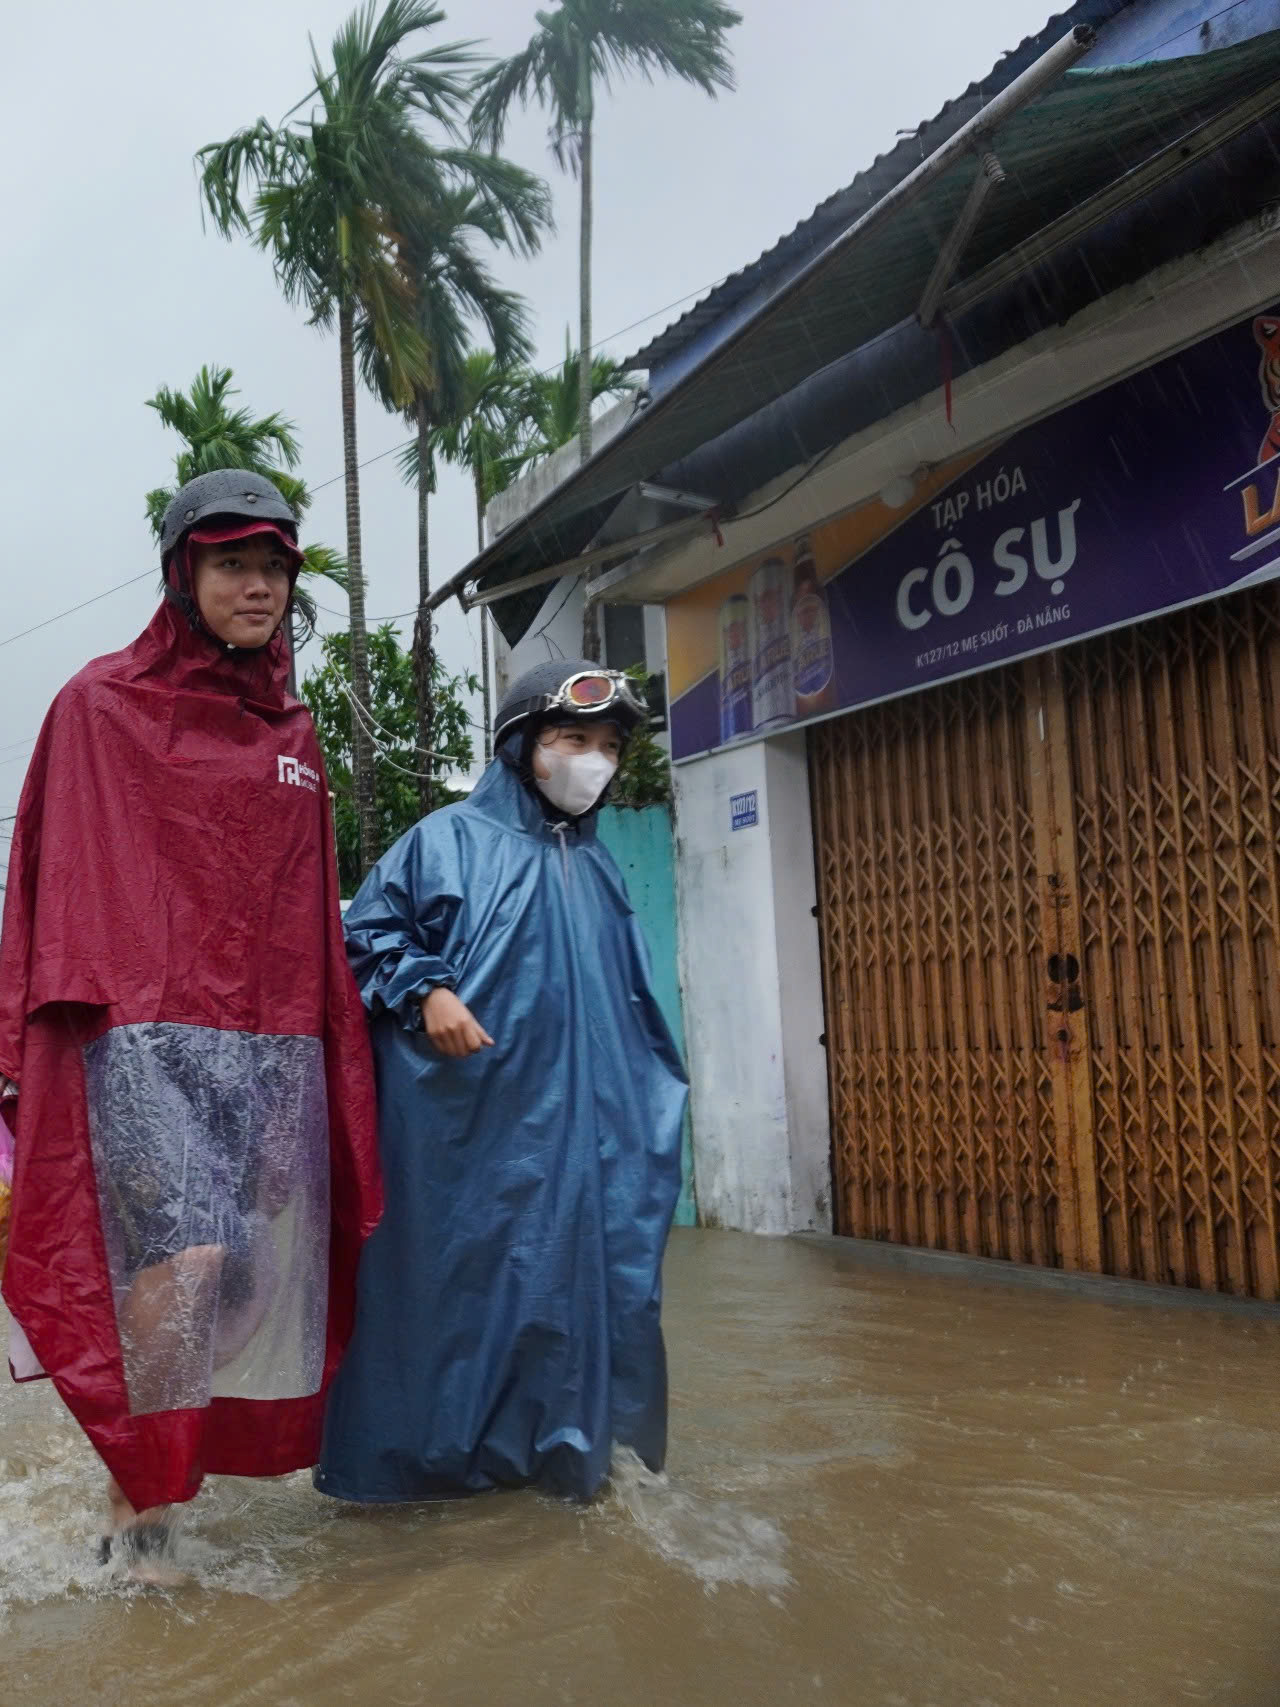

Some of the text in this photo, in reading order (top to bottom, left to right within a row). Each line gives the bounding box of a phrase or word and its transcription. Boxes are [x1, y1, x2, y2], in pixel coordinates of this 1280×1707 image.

[931, 466, 1027, 531] TẠP HÓA
[896, 498, 1081, 631] CÔ SỰ
[916, 641, 960, 668] K127/12
[980, 622, 1009, 647] SUỐT
[1017, 614, 1034, 634] ĐÀ
